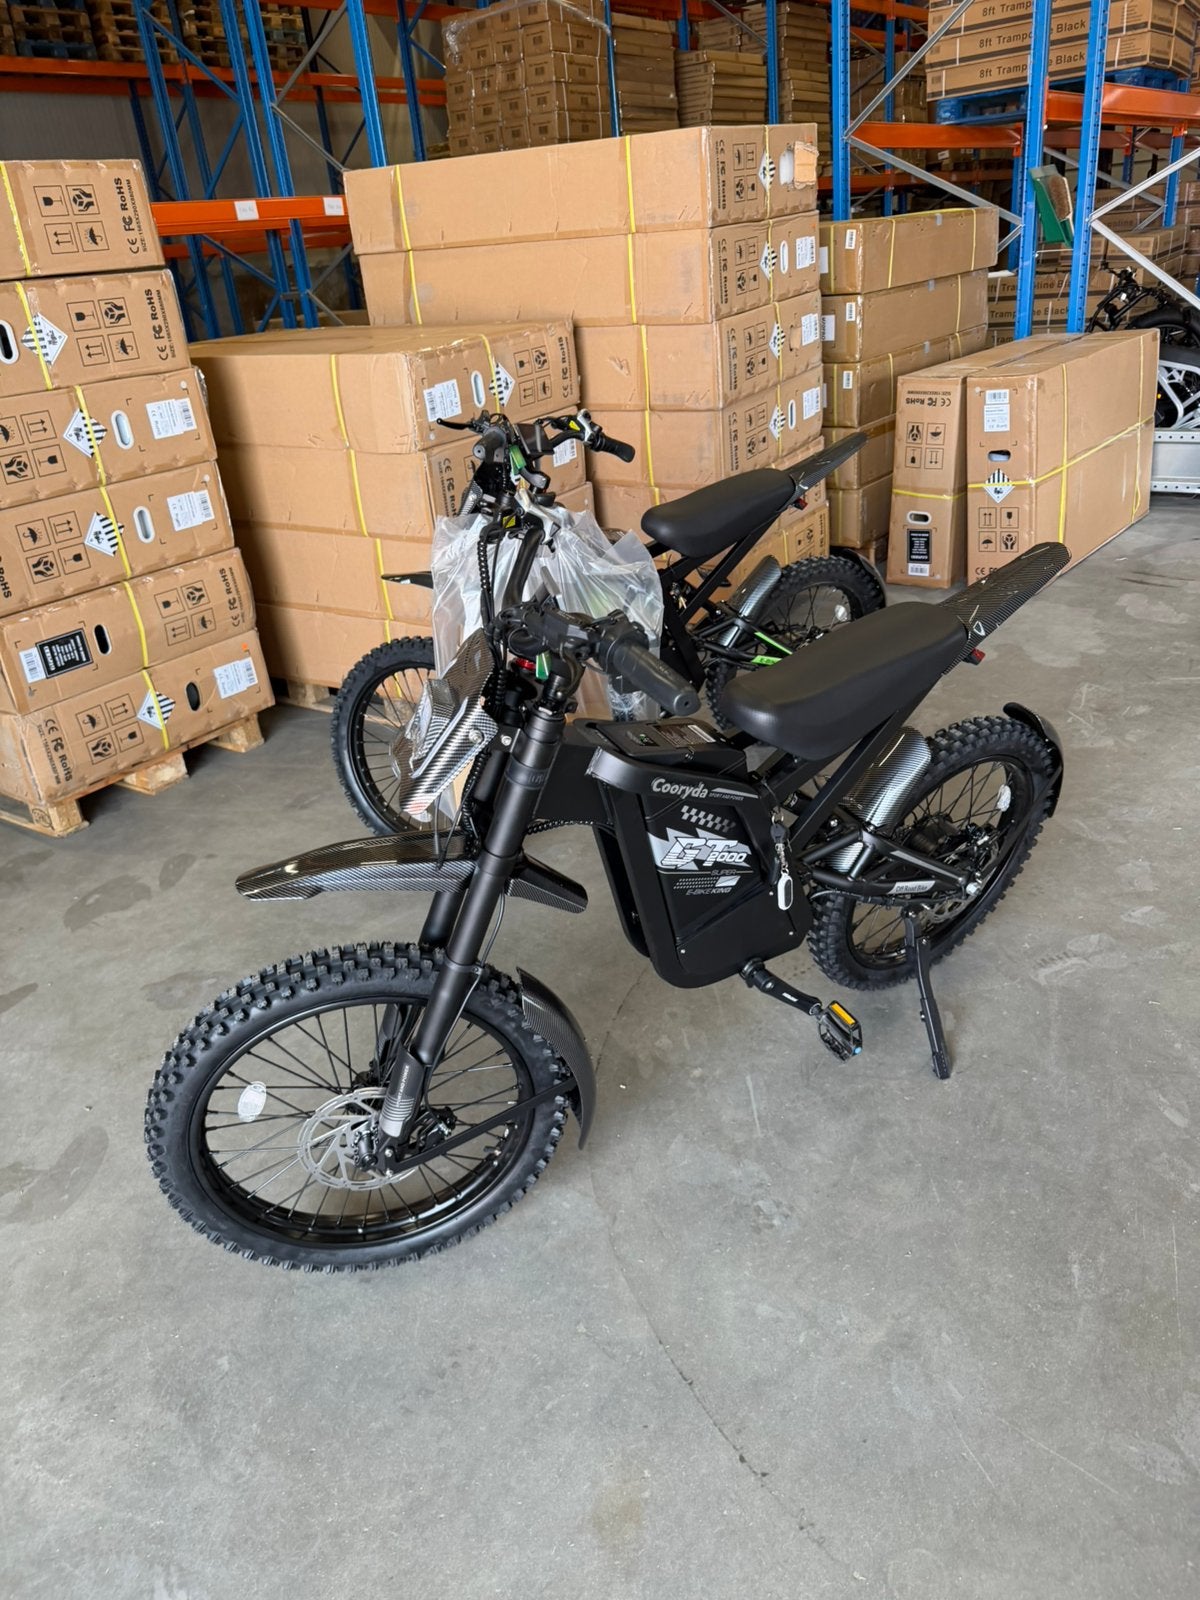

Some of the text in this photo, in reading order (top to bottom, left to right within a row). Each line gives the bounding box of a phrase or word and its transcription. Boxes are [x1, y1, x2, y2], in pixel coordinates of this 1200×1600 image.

[982, 5, 996, 17] 8ft
[979, 38, 992, 48] 8ft
[1056, 19, 1086, 33] Black
[980, 67, 992, 78] 8ft
[1055, 51, 1085, 65] Black
[114, 177, 128, 211] RoHS
[144, 288, 158, 321] RoHS
[558, 336, 567, 364] RoHS
[905, 397, 925, 405] RoHS
[219, 568, 233, 595] RoHS
[975, 566, 986, 576] CE
[45, 718, 59, 735] CE
[59, 754, 73, 782] RoHS
[652, 777, 709, 799] Cooryda
[707, 851, 747, 863] 2000
